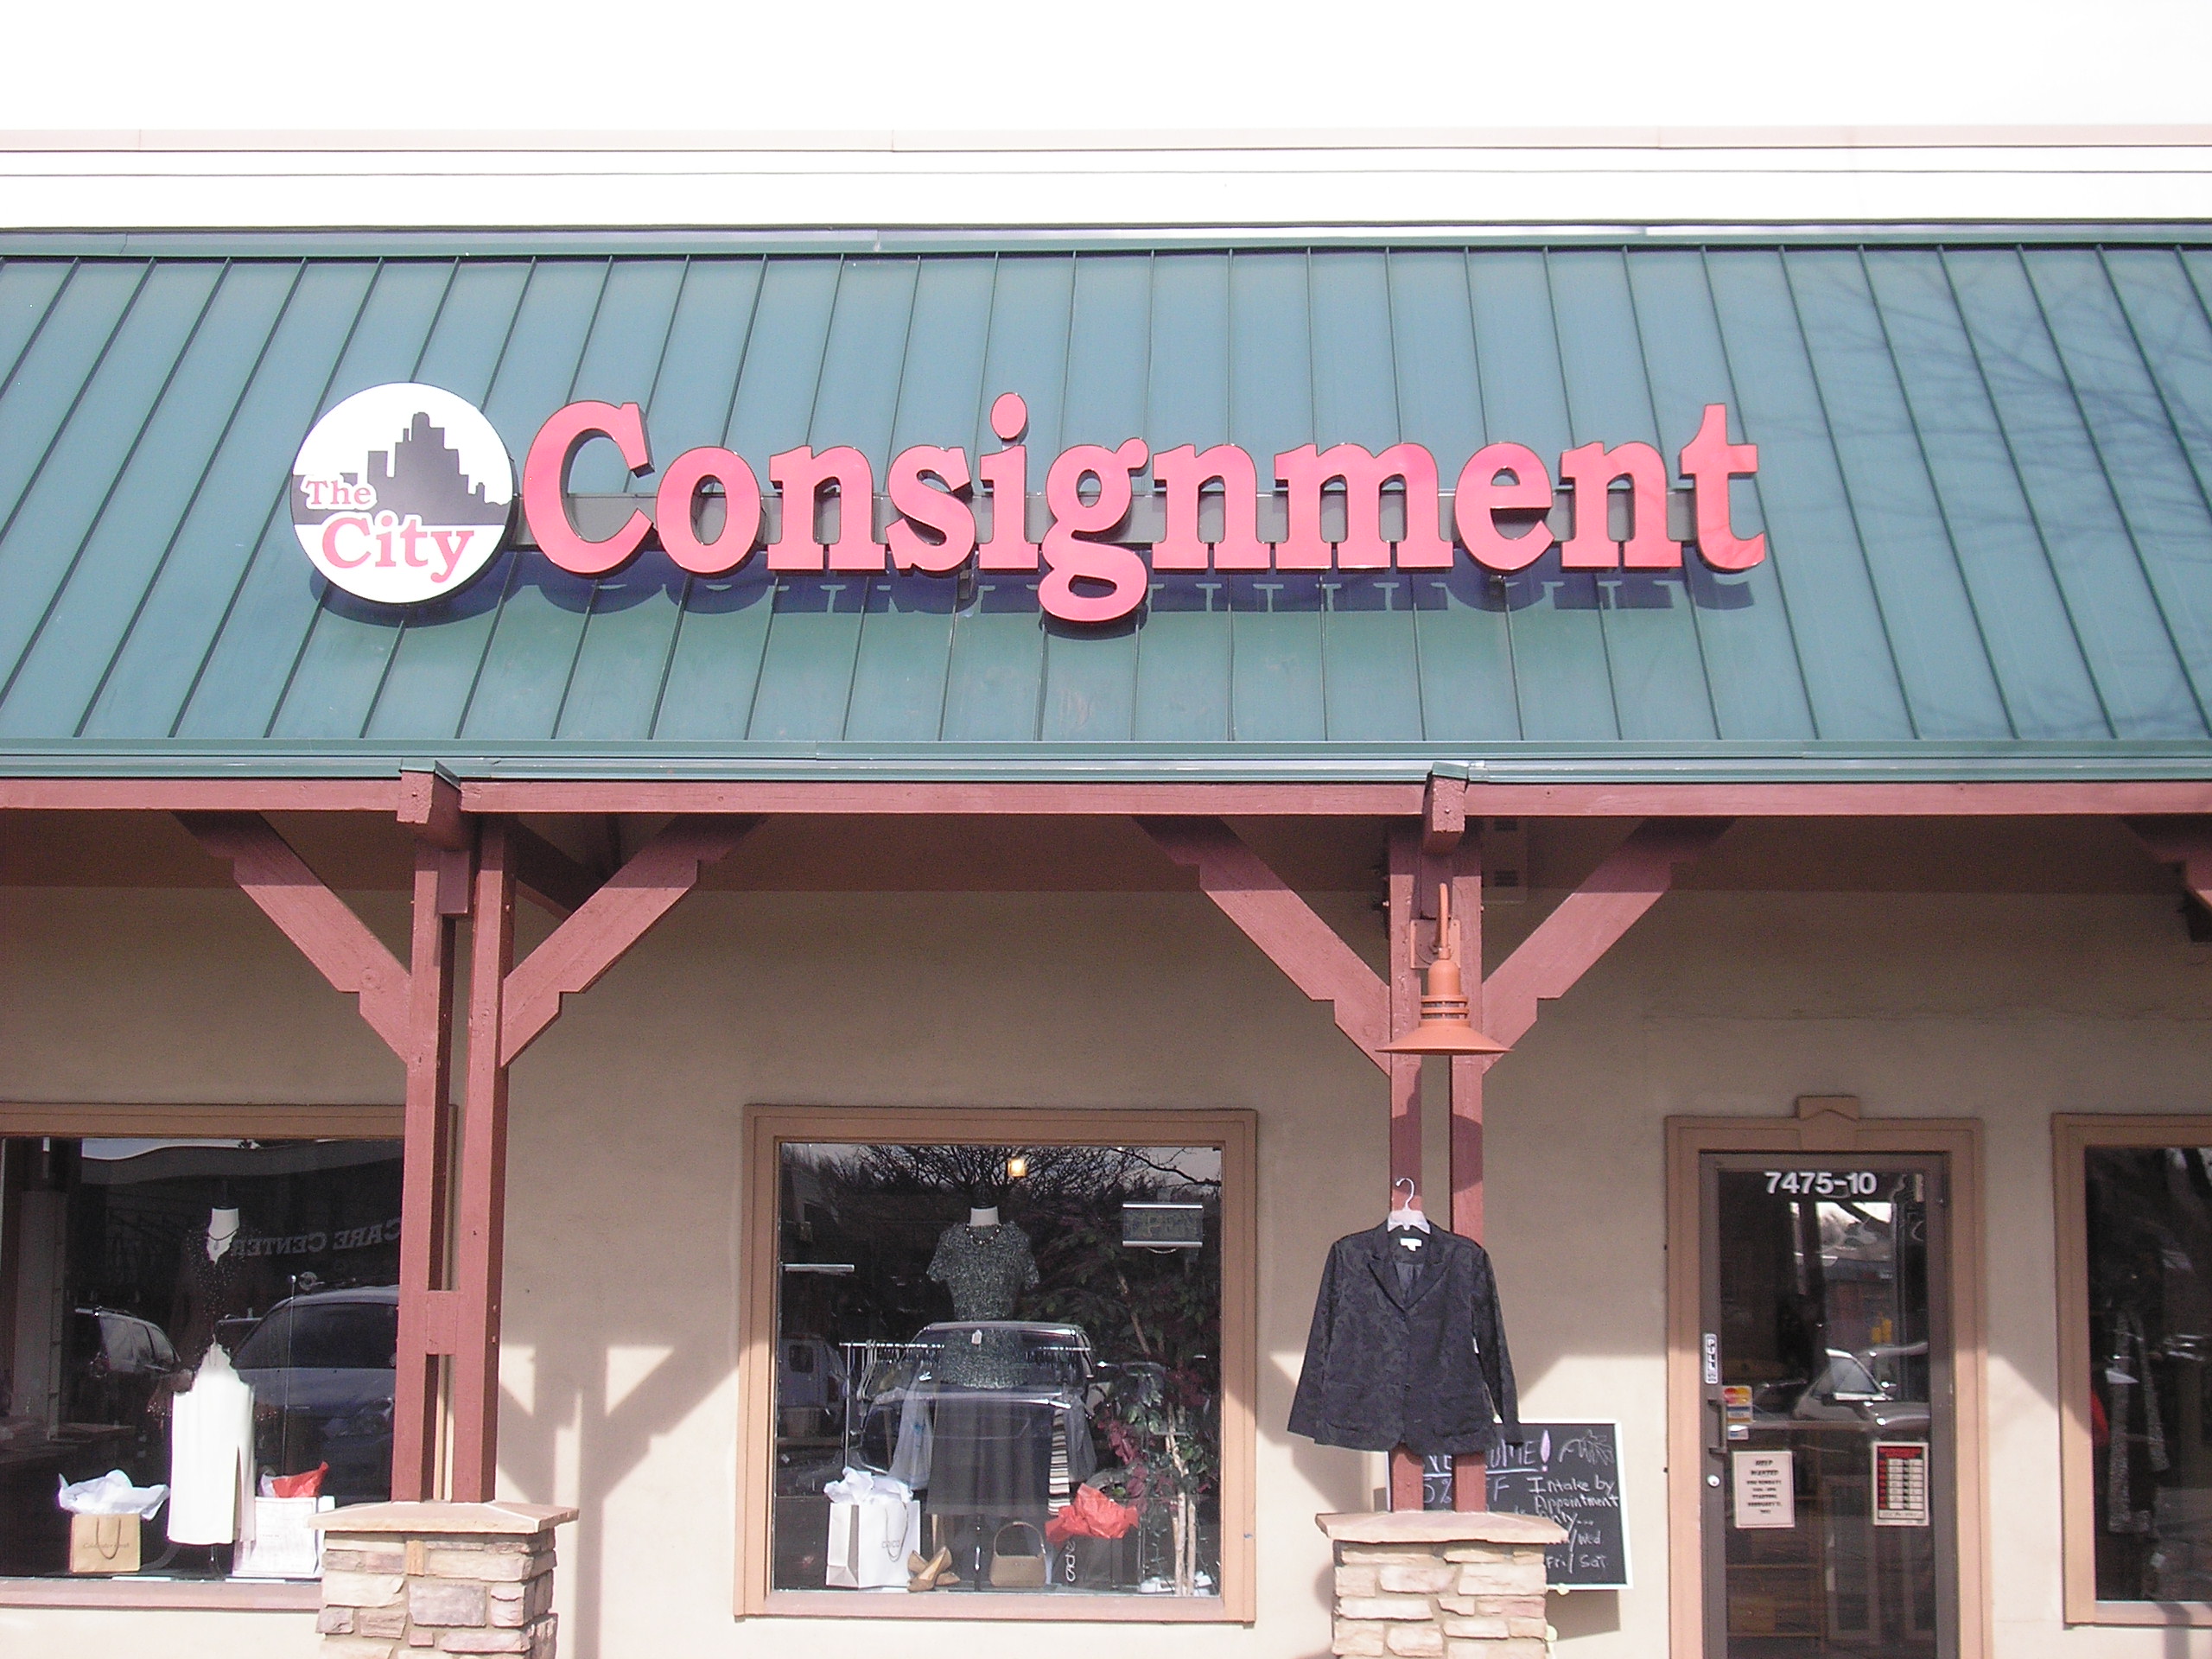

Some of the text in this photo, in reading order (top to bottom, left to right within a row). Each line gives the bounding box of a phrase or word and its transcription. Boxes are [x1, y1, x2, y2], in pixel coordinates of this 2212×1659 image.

[305, 480, 372, 505] The
[523, 392, 1766, 624] Consignment
[321, 514, 474, 583] City
[1764, 1172, 1877, 1195] 7475-10
[1707, 1338, 1717, 1370] PULL
[1595, 1474, 1616, 1496] by
